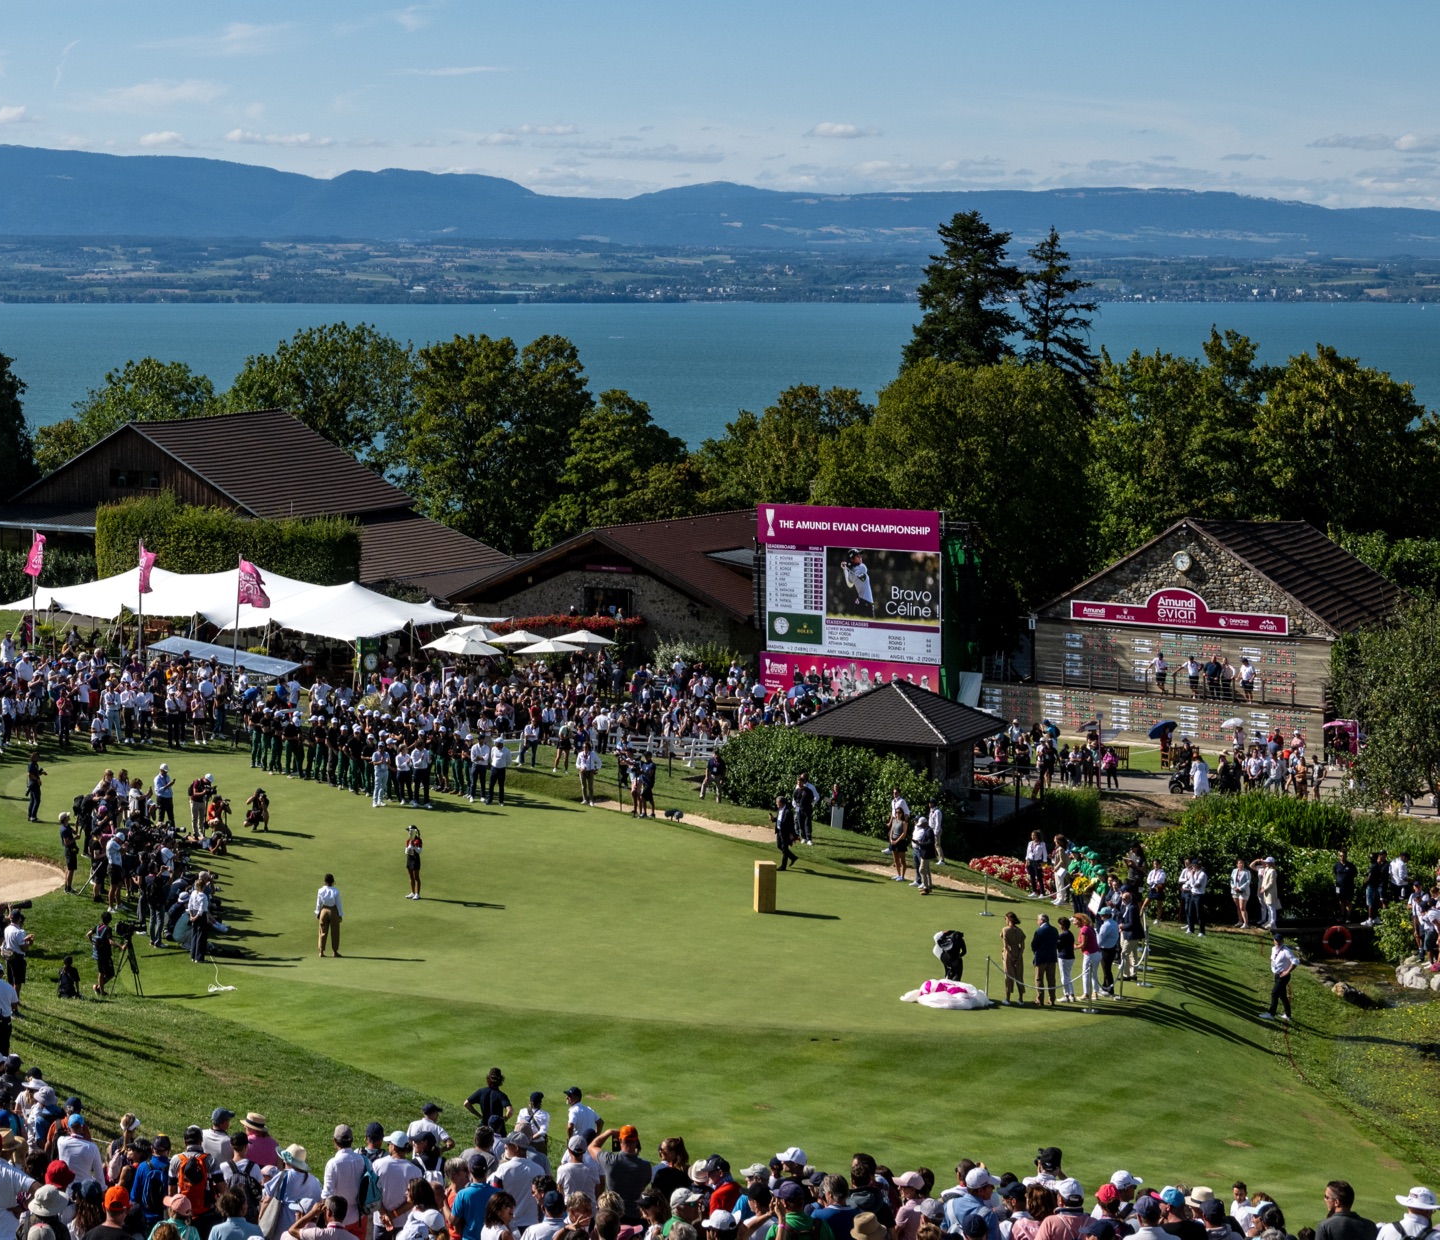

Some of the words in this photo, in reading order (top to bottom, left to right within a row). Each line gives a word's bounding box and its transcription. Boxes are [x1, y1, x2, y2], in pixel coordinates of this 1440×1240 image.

[778, 520, 794, 529] THE
[796, 520, 830, 530] AMUNDI
[832, 522, 858, 532] EVIAN
[860, 523, 930, 535] CHAMPIONSHIP
[891, 586, 932, 602] Bravo
[886, 601, 931, 618] Céline
[1157, 596, 1196, 608] Amundi
[1157, 608, 1196, 620] evian
